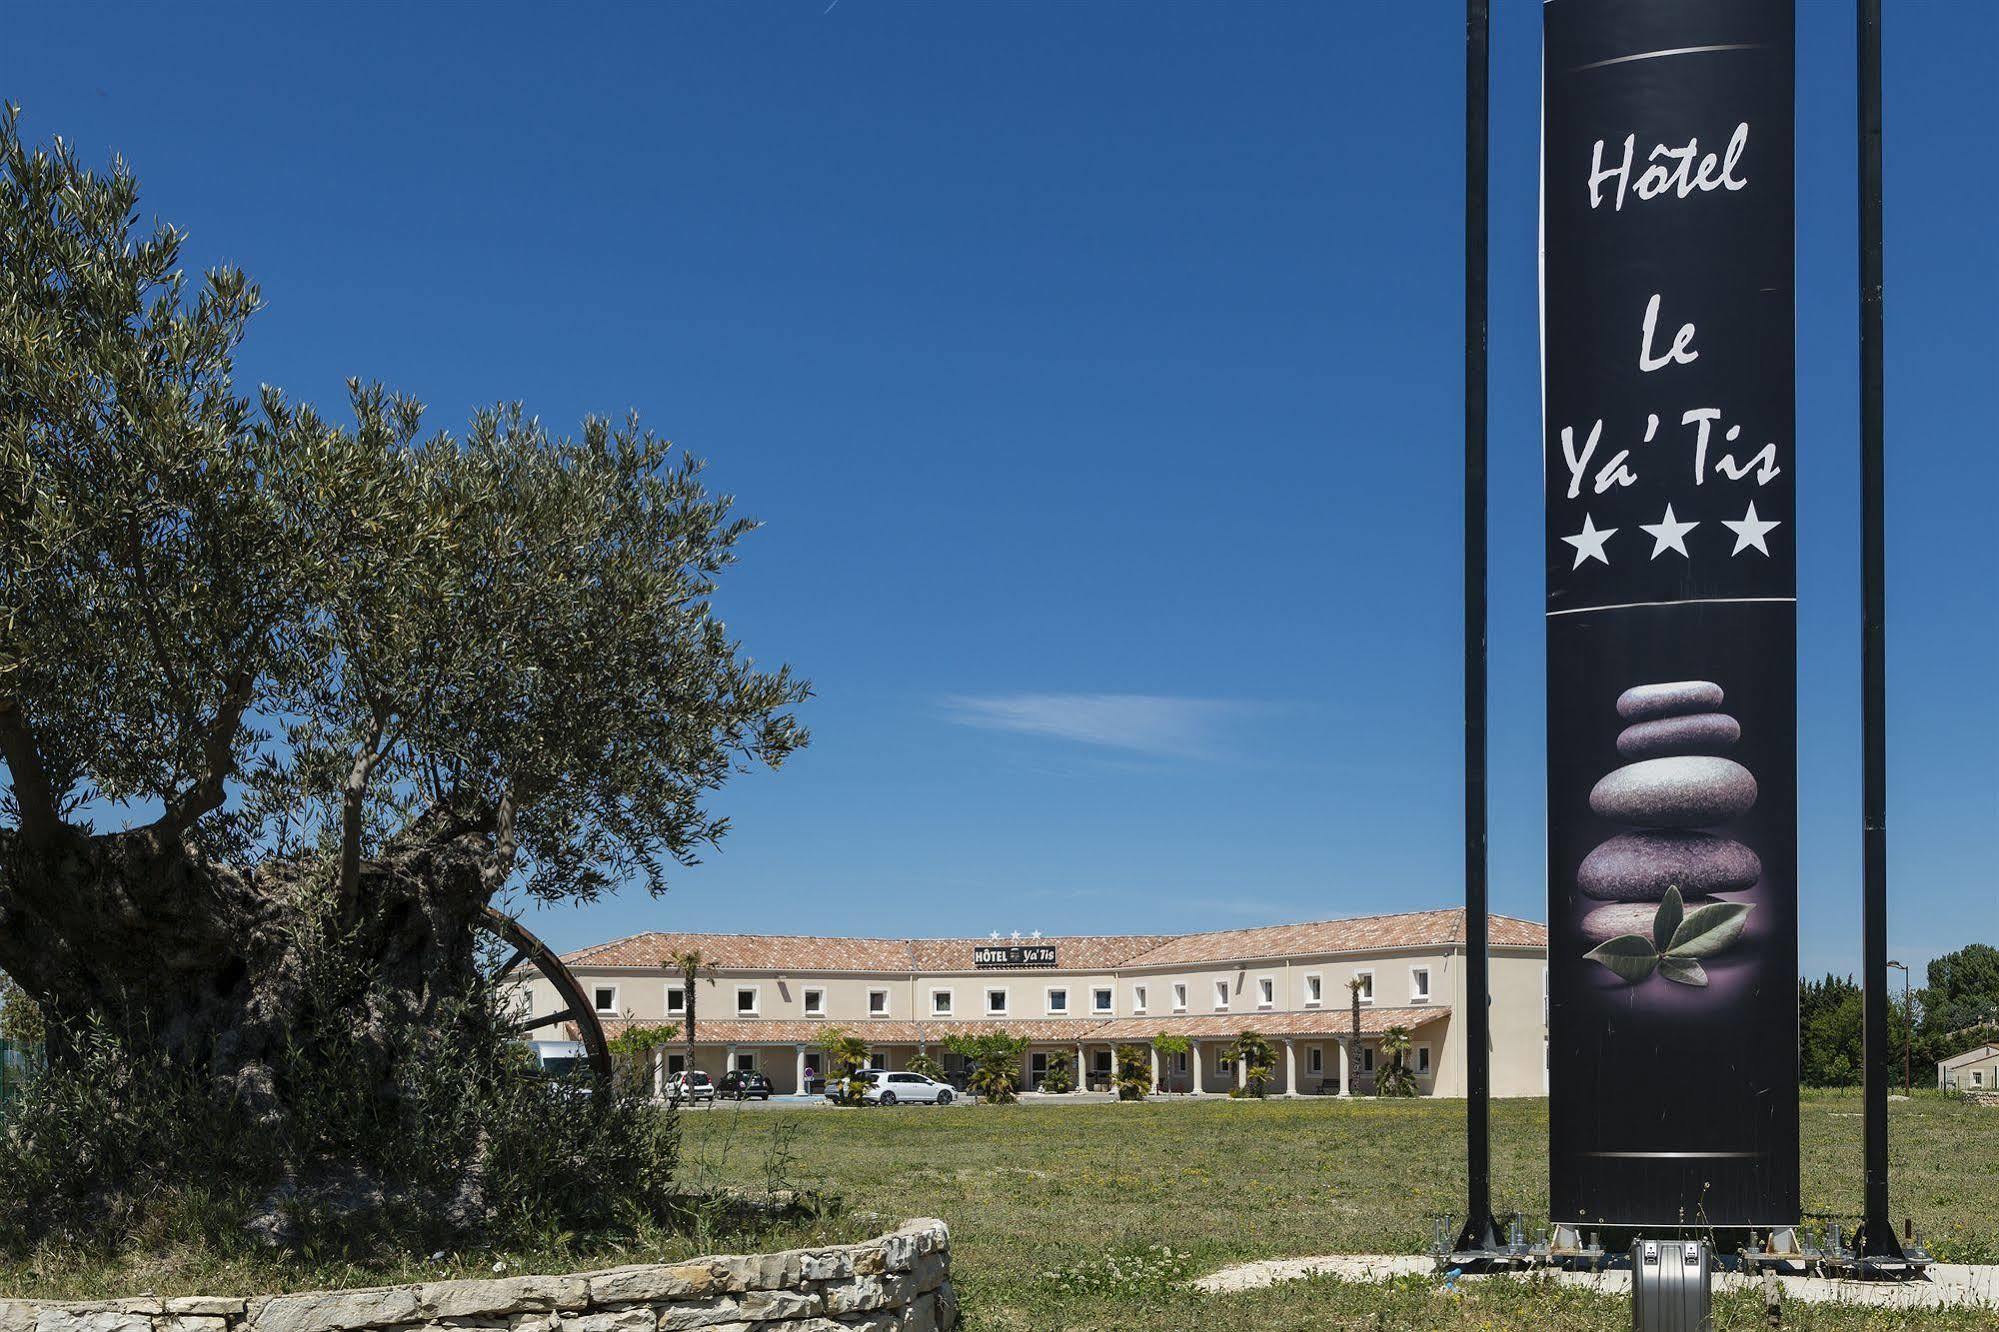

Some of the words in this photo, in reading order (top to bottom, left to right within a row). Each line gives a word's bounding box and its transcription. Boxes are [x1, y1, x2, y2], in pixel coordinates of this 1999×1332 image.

[1587, 121, 1749, 212] Hôtel
[1639, 293, 1699, 373] Le
[975, 949, 1008, 962] HÔTEL
